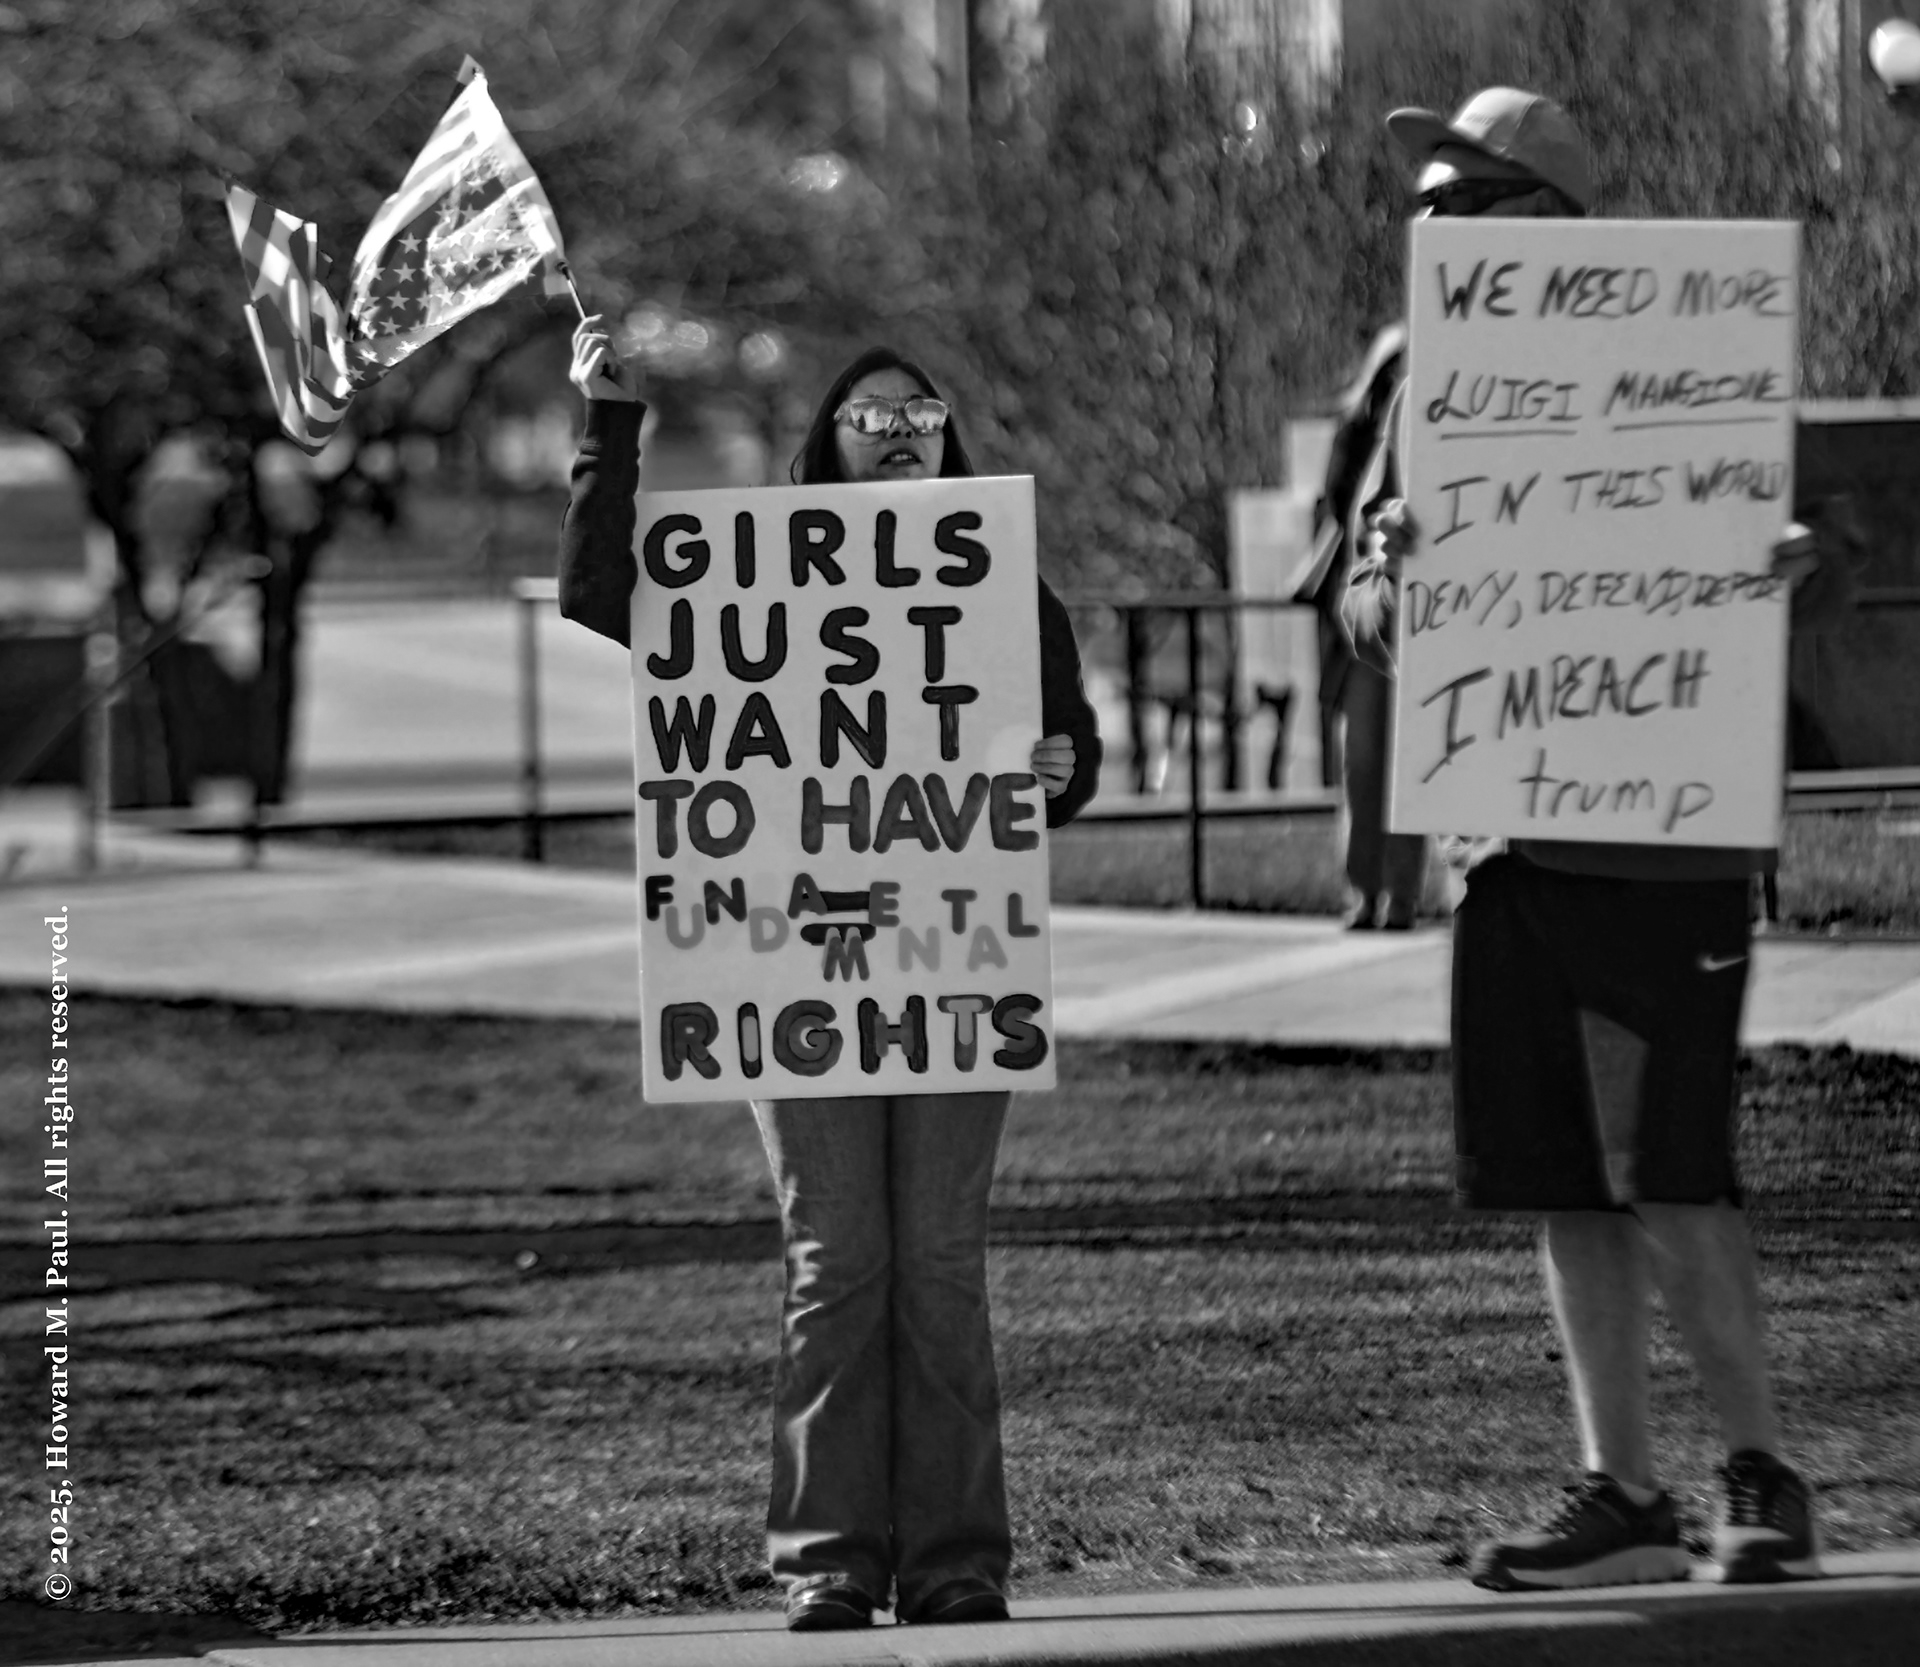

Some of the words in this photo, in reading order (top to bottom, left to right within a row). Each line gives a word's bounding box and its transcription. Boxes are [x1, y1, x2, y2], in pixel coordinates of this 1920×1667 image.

[1437, 258, 1523, 320] WE
[1539, 265, 1659, 319] NEED
[1673, 267, 1795, 318] MORE
[1427, 370, 1583, 423] LUIGI
[1434, 472, 1542, 545] IN
[1564, 465, 1673, 513] THIS
[1684, 456, 1787, 504] WORLD
[643, 508, 992, 589] GIRLS
[647, 598, 964, 685] JUST
[1407, 570, 1523, 637] DENY,
[648, 684, 980, 773] WANT
[1421, 648, 1713, 784] IMPEACH
[639, 779, 757, 859] TO
[800, 772, 1041, 855] HAVE
[1518, 747, 1715, 834] trump
[644, 872, 1041, 983] FUNDAMENTAL
[660, 993, 1049, 1082] RIGHTS
